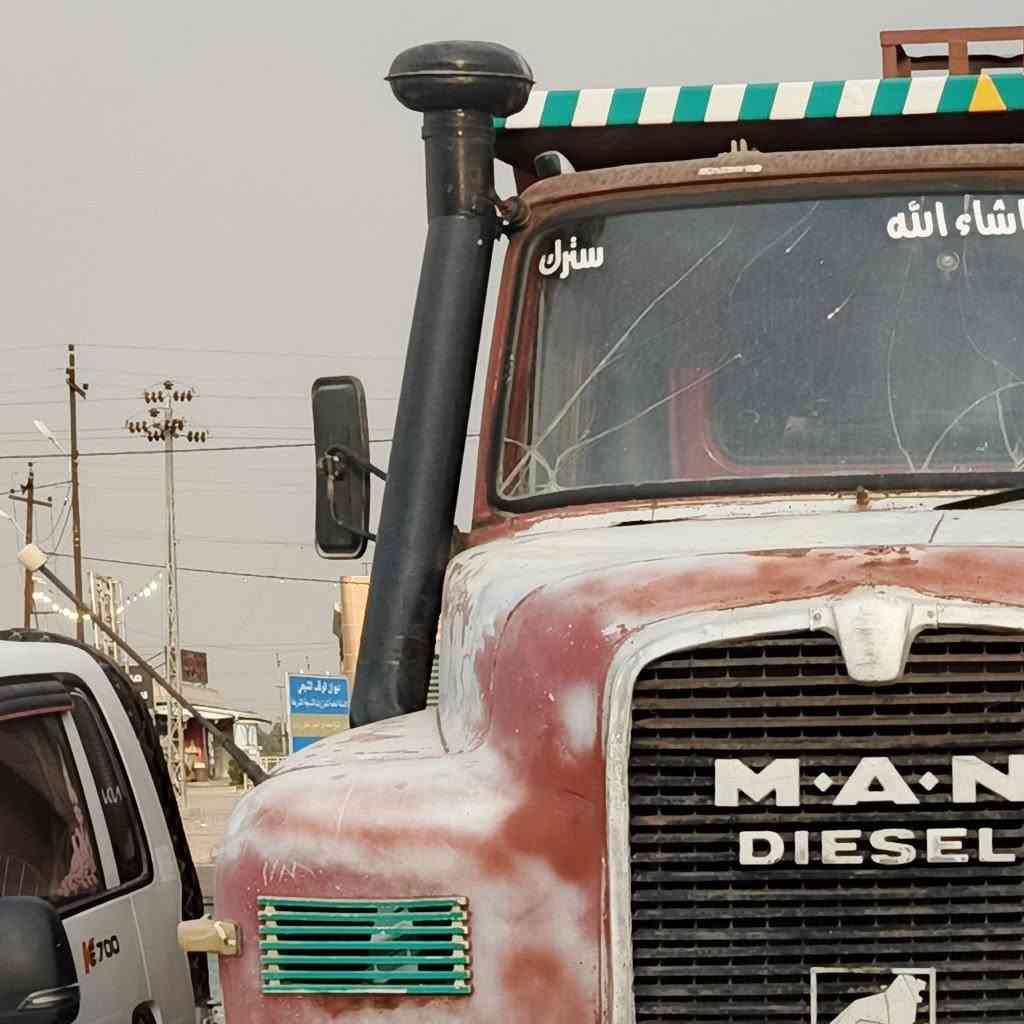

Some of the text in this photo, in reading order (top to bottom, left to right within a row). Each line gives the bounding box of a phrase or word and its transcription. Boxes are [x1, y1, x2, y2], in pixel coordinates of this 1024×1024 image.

[886, 199, 948, 240] الله
[538, 236, 604, 280] سترك
[738, 827, 1017, 865] DIESEL
